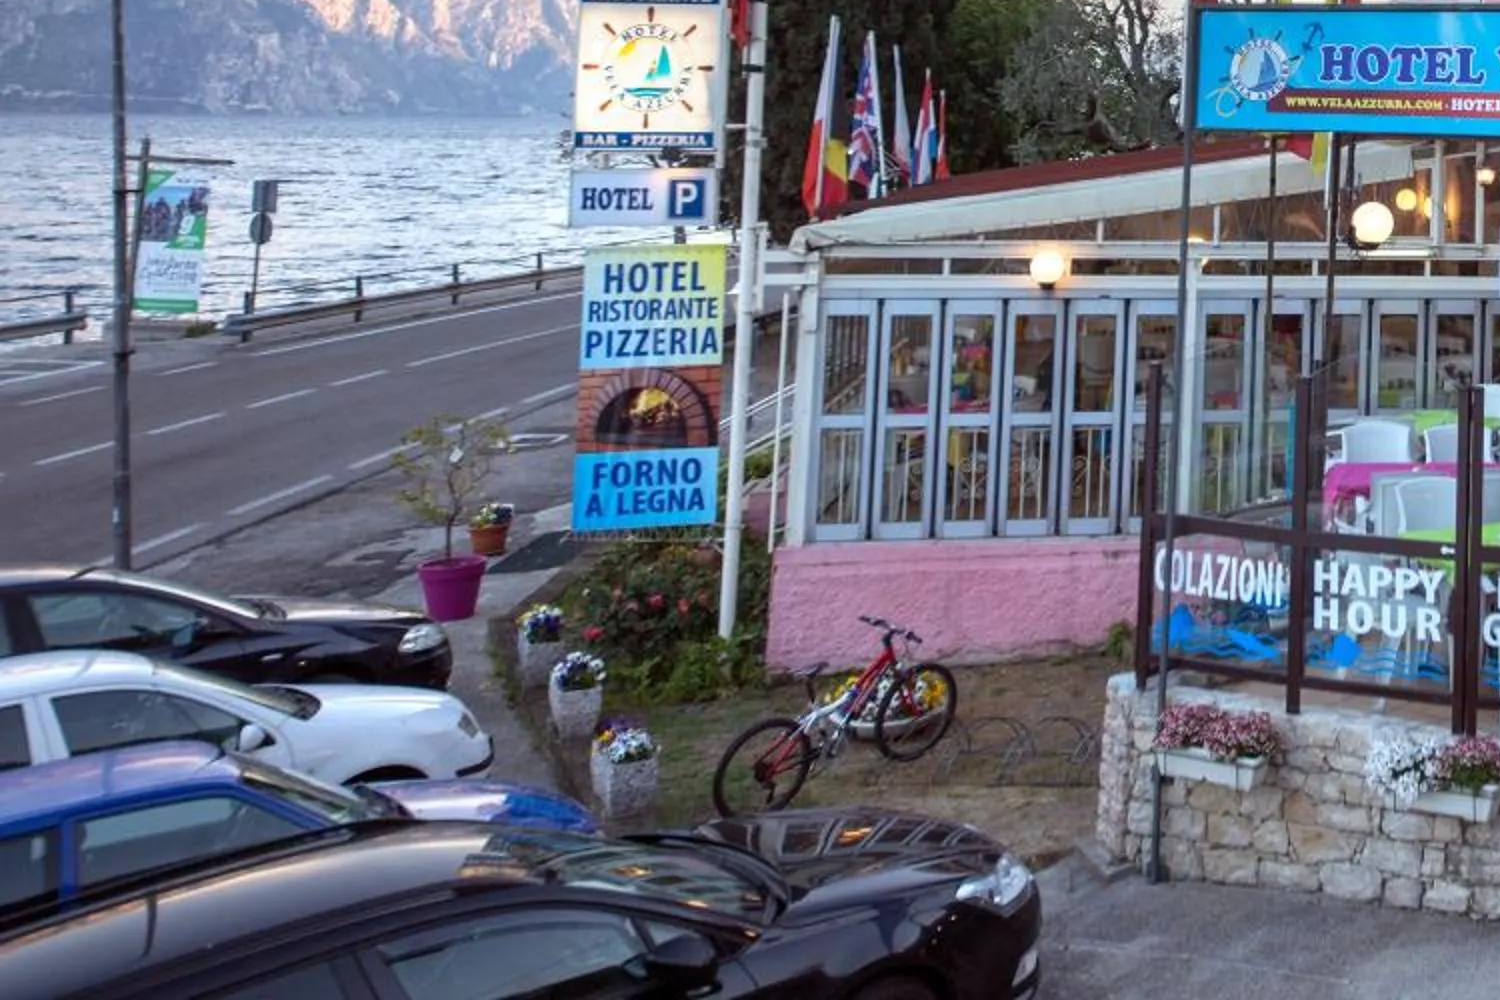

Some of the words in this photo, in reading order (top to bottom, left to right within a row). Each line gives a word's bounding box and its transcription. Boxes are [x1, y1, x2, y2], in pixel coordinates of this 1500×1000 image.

[621, 24, 678, 41] HOTEL
[1319, 46, 1484, 85] HOTEL
[1284, 96, 1443, 112] WWW.VELAAZZURRA.COM
[582, 134, 618, 146] BAR
[631, 134, 708, 147] PIZZERIA
[580, 186, 653, 211] HOTEL
[675, 181, 698, 215] P
[603, 261, 706, 295] HOTEL
[588, 297, 719, 323] RISTORANTE
[584, 326, 719, 360] PIZZERIA
[591, 457, 702, 490] FORNO
[585, 493, 604, 519] A
[617, 487, 706, 516] LEGNA
[1313, 559, 1447, 604] HAPPY
[1313, 595, 1442, 643] HOUR
